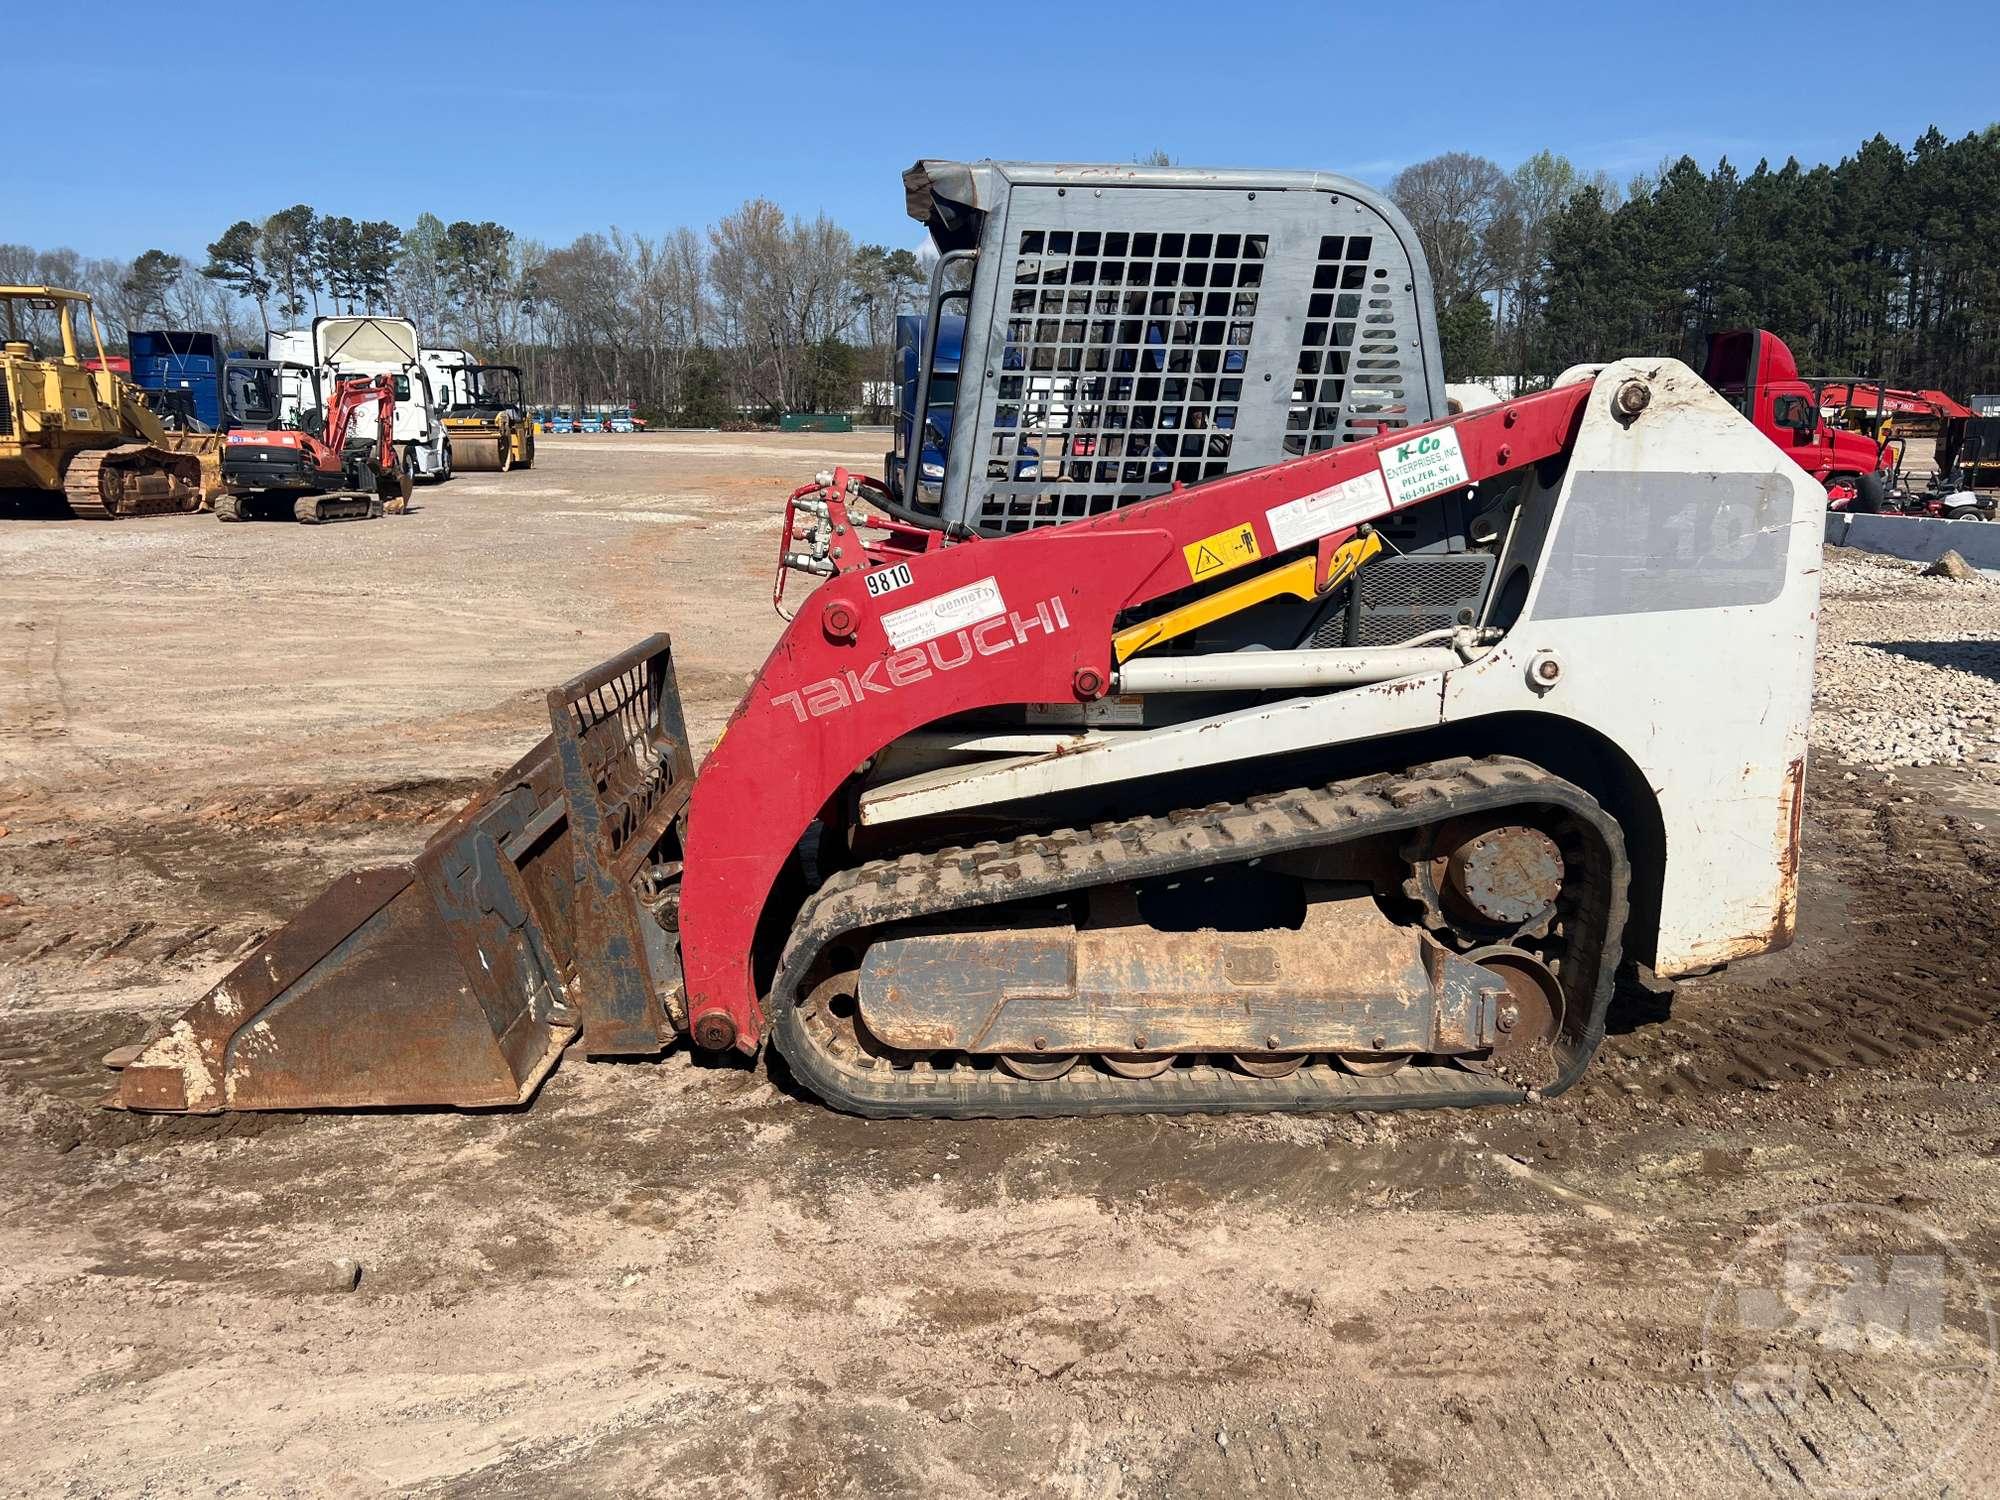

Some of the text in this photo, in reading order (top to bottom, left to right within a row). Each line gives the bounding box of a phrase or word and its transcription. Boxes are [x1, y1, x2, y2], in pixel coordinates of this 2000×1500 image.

[1396, 436, 1441, 463] K-Co
[1438, 463, 1451, 474] SC
[867, 564, 911, 595] 9810
